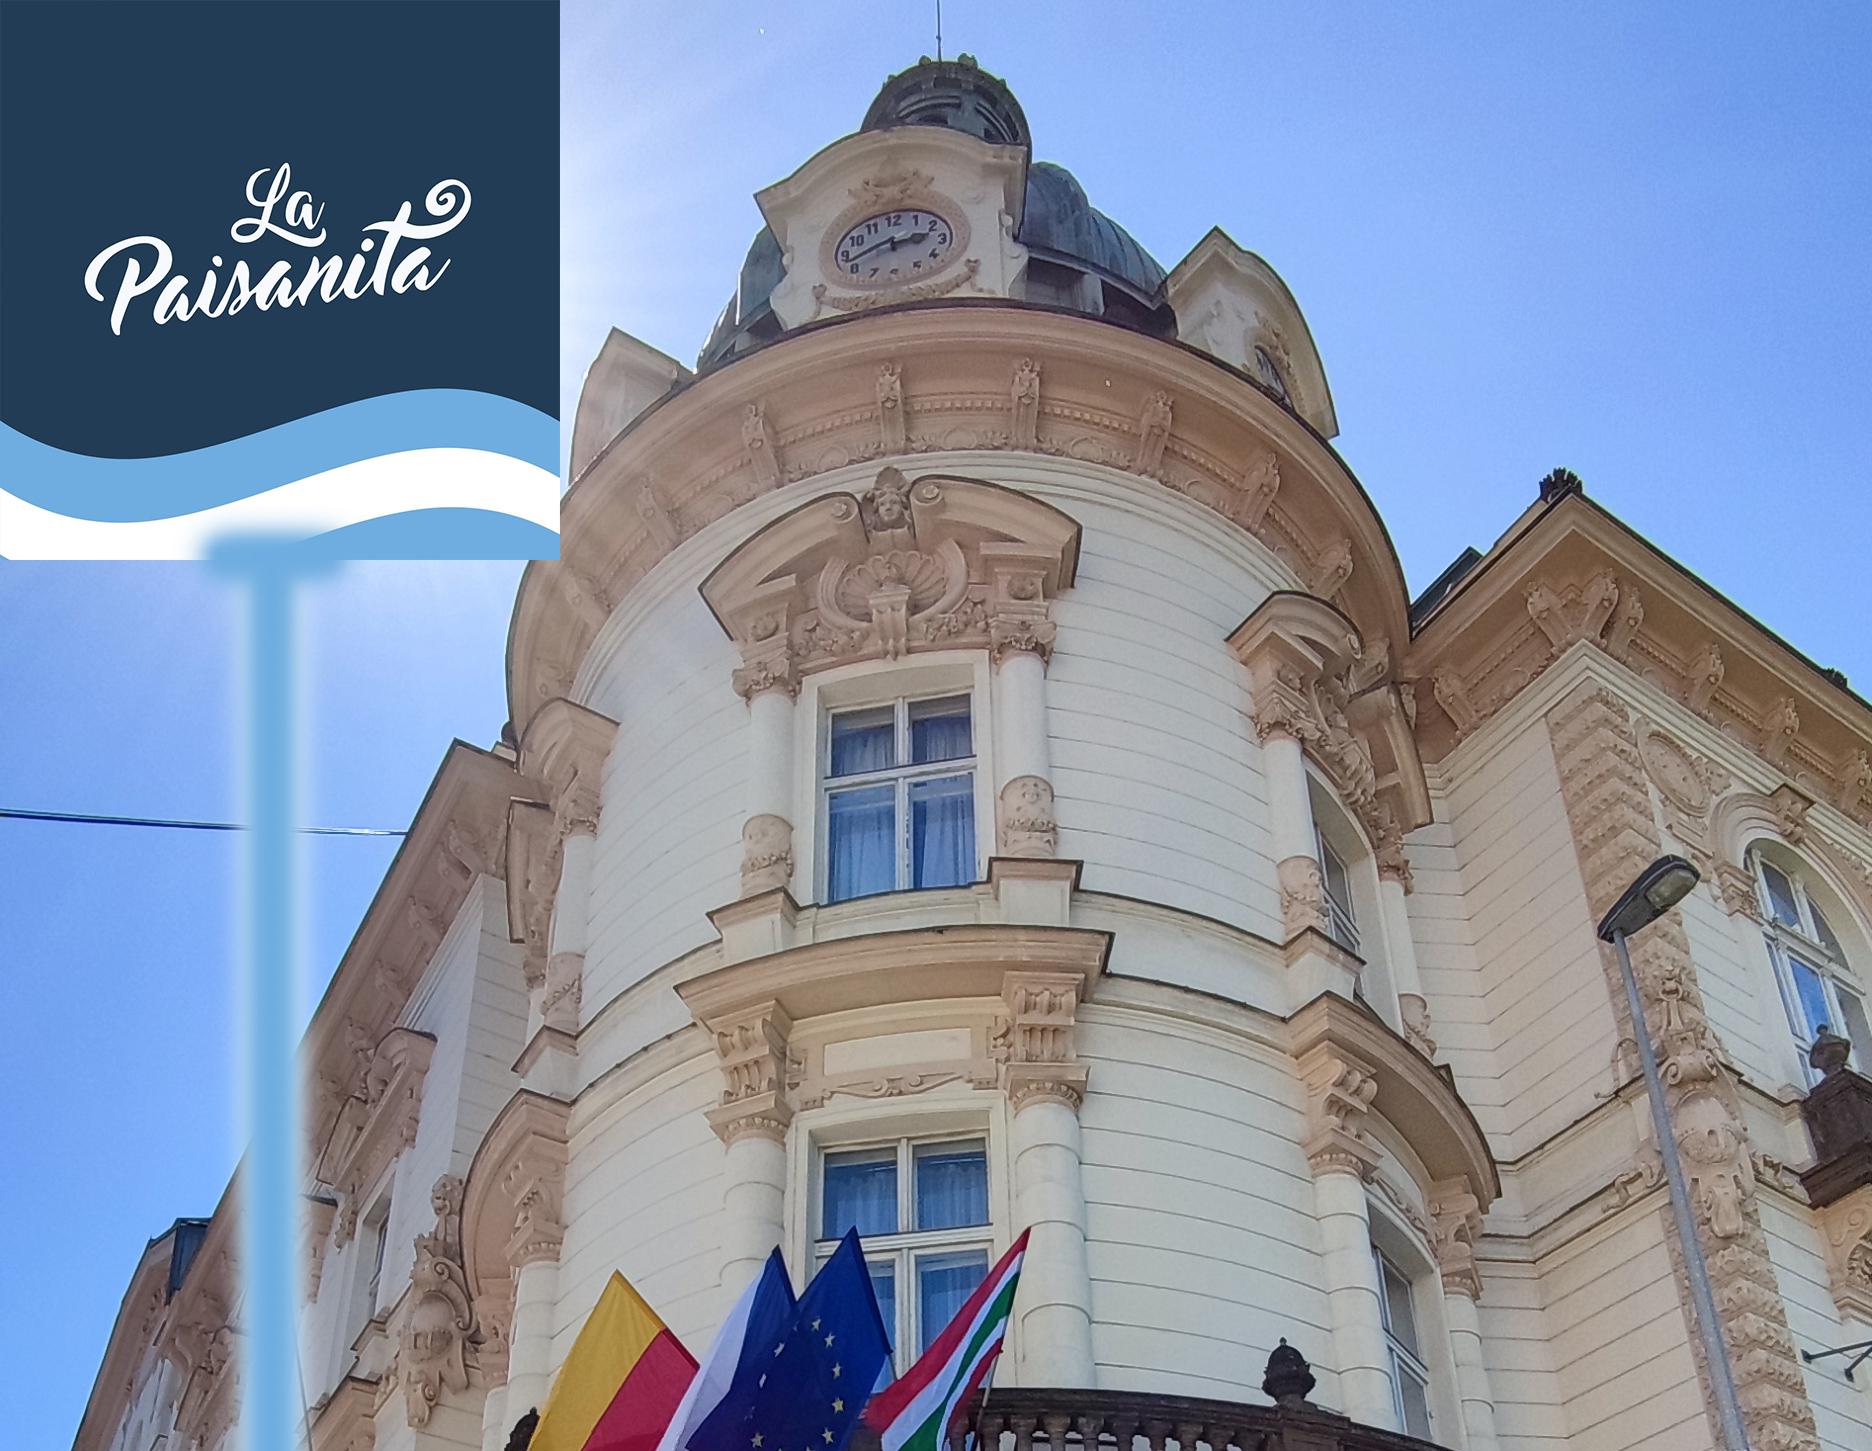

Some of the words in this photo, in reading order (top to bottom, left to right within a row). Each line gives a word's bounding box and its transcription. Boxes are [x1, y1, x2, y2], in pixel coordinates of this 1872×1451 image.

[885, 214, 901, 227] 12
[913, 215, 919, 226] 1
[929, 220, 937, 232] 2
[865, 222, 878, 235] 11
[849, 234, 864, 247] 10
[938, 233, 947, 244] 3
[929, 248, 939, 259] 4
